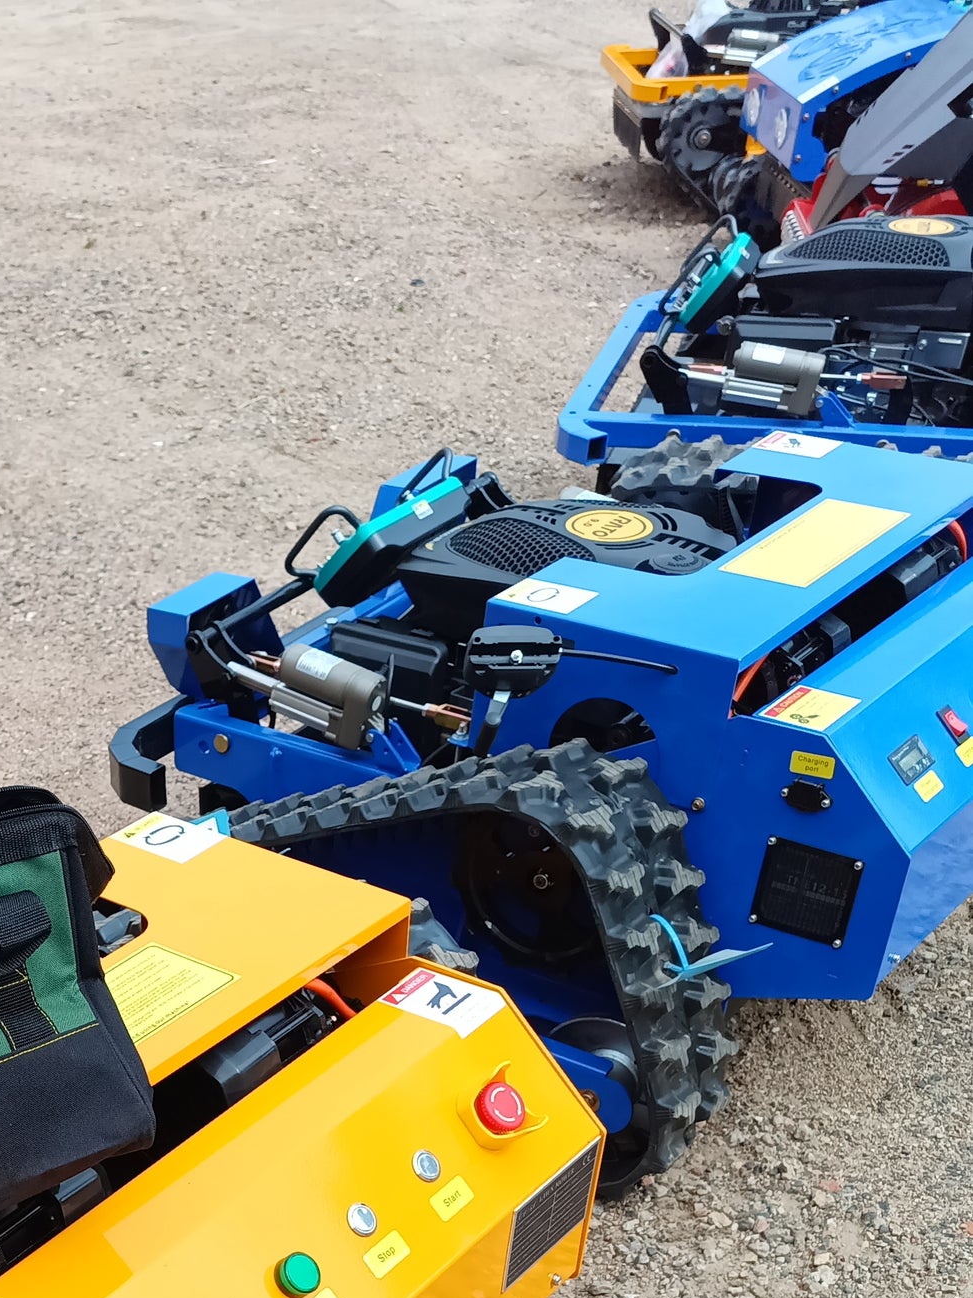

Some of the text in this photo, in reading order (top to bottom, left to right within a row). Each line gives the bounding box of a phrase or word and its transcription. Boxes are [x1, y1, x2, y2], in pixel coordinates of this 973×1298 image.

[592, 515, 633, 538] RATO
[797, 754, 829, 767] Charging
[805, 764, 820, 774] port
[401, 973, 429, 994] DANGER
[443, 1189, 462, 1208] Start
[377, 1245, 396, 1263] Stop
